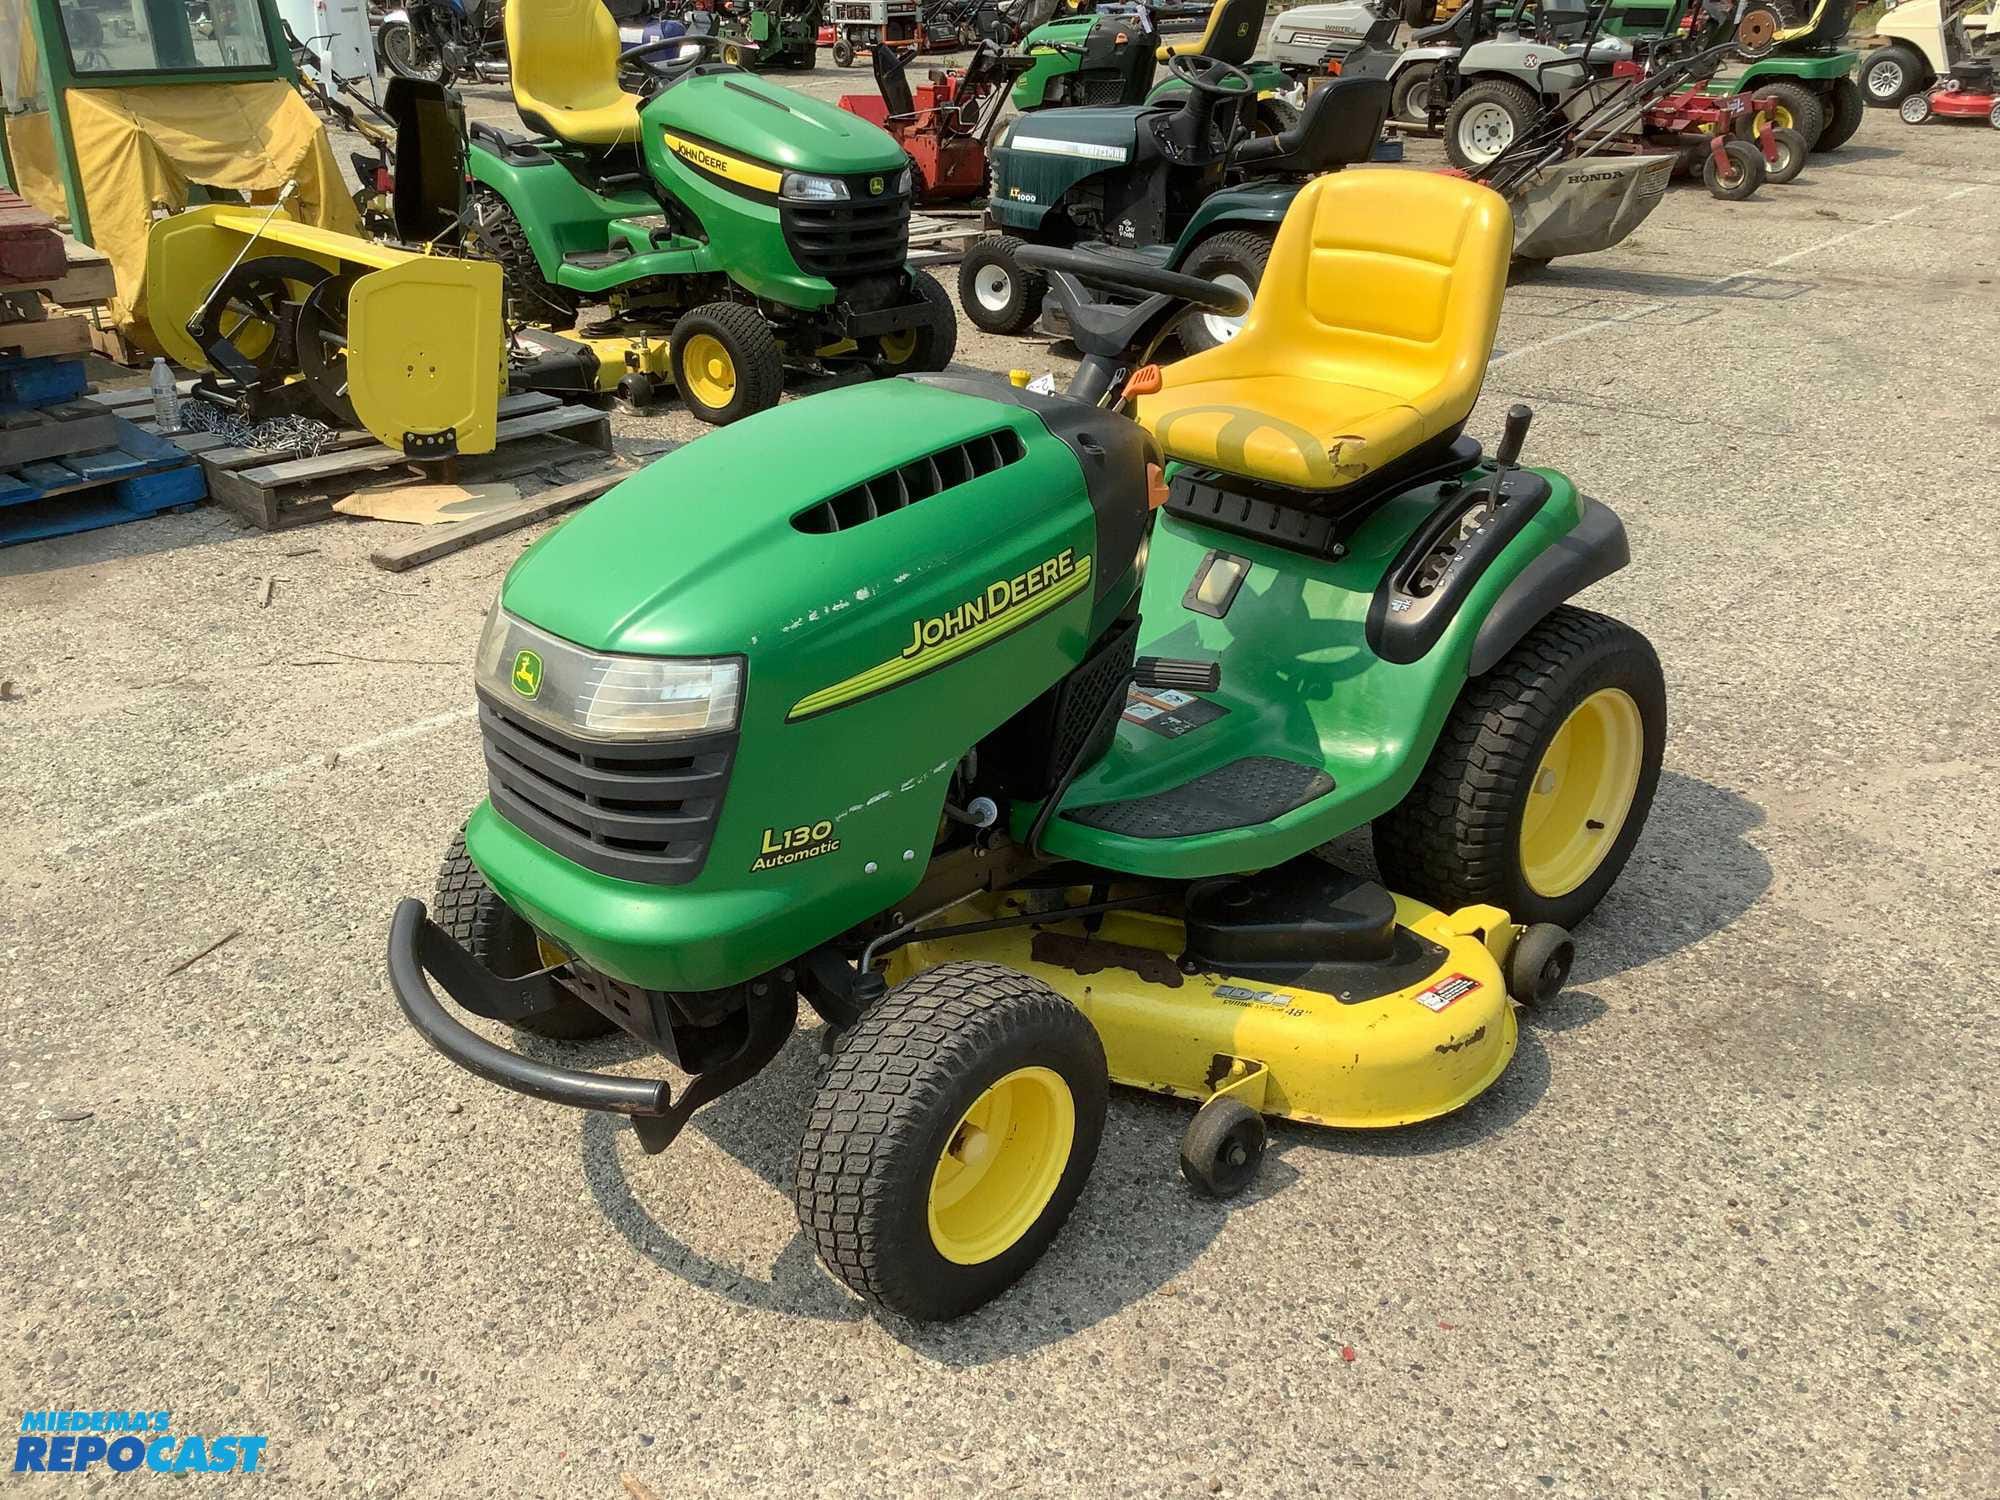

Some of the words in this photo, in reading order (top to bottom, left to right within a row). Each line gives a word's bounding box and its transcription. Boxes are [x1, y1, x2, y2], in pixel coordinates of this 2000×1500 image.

[677, 141, 698, 161] JOHN
[698, 150, 728, 172] DEERE
[1567, 170, 1625, 184] HONDA
[902, 595, 984, 659] JOHN
[985, 546, 1078, 617] DEERE
[761, 819, 834, 855] L130
[750, 838, 841, 872] Automatic
